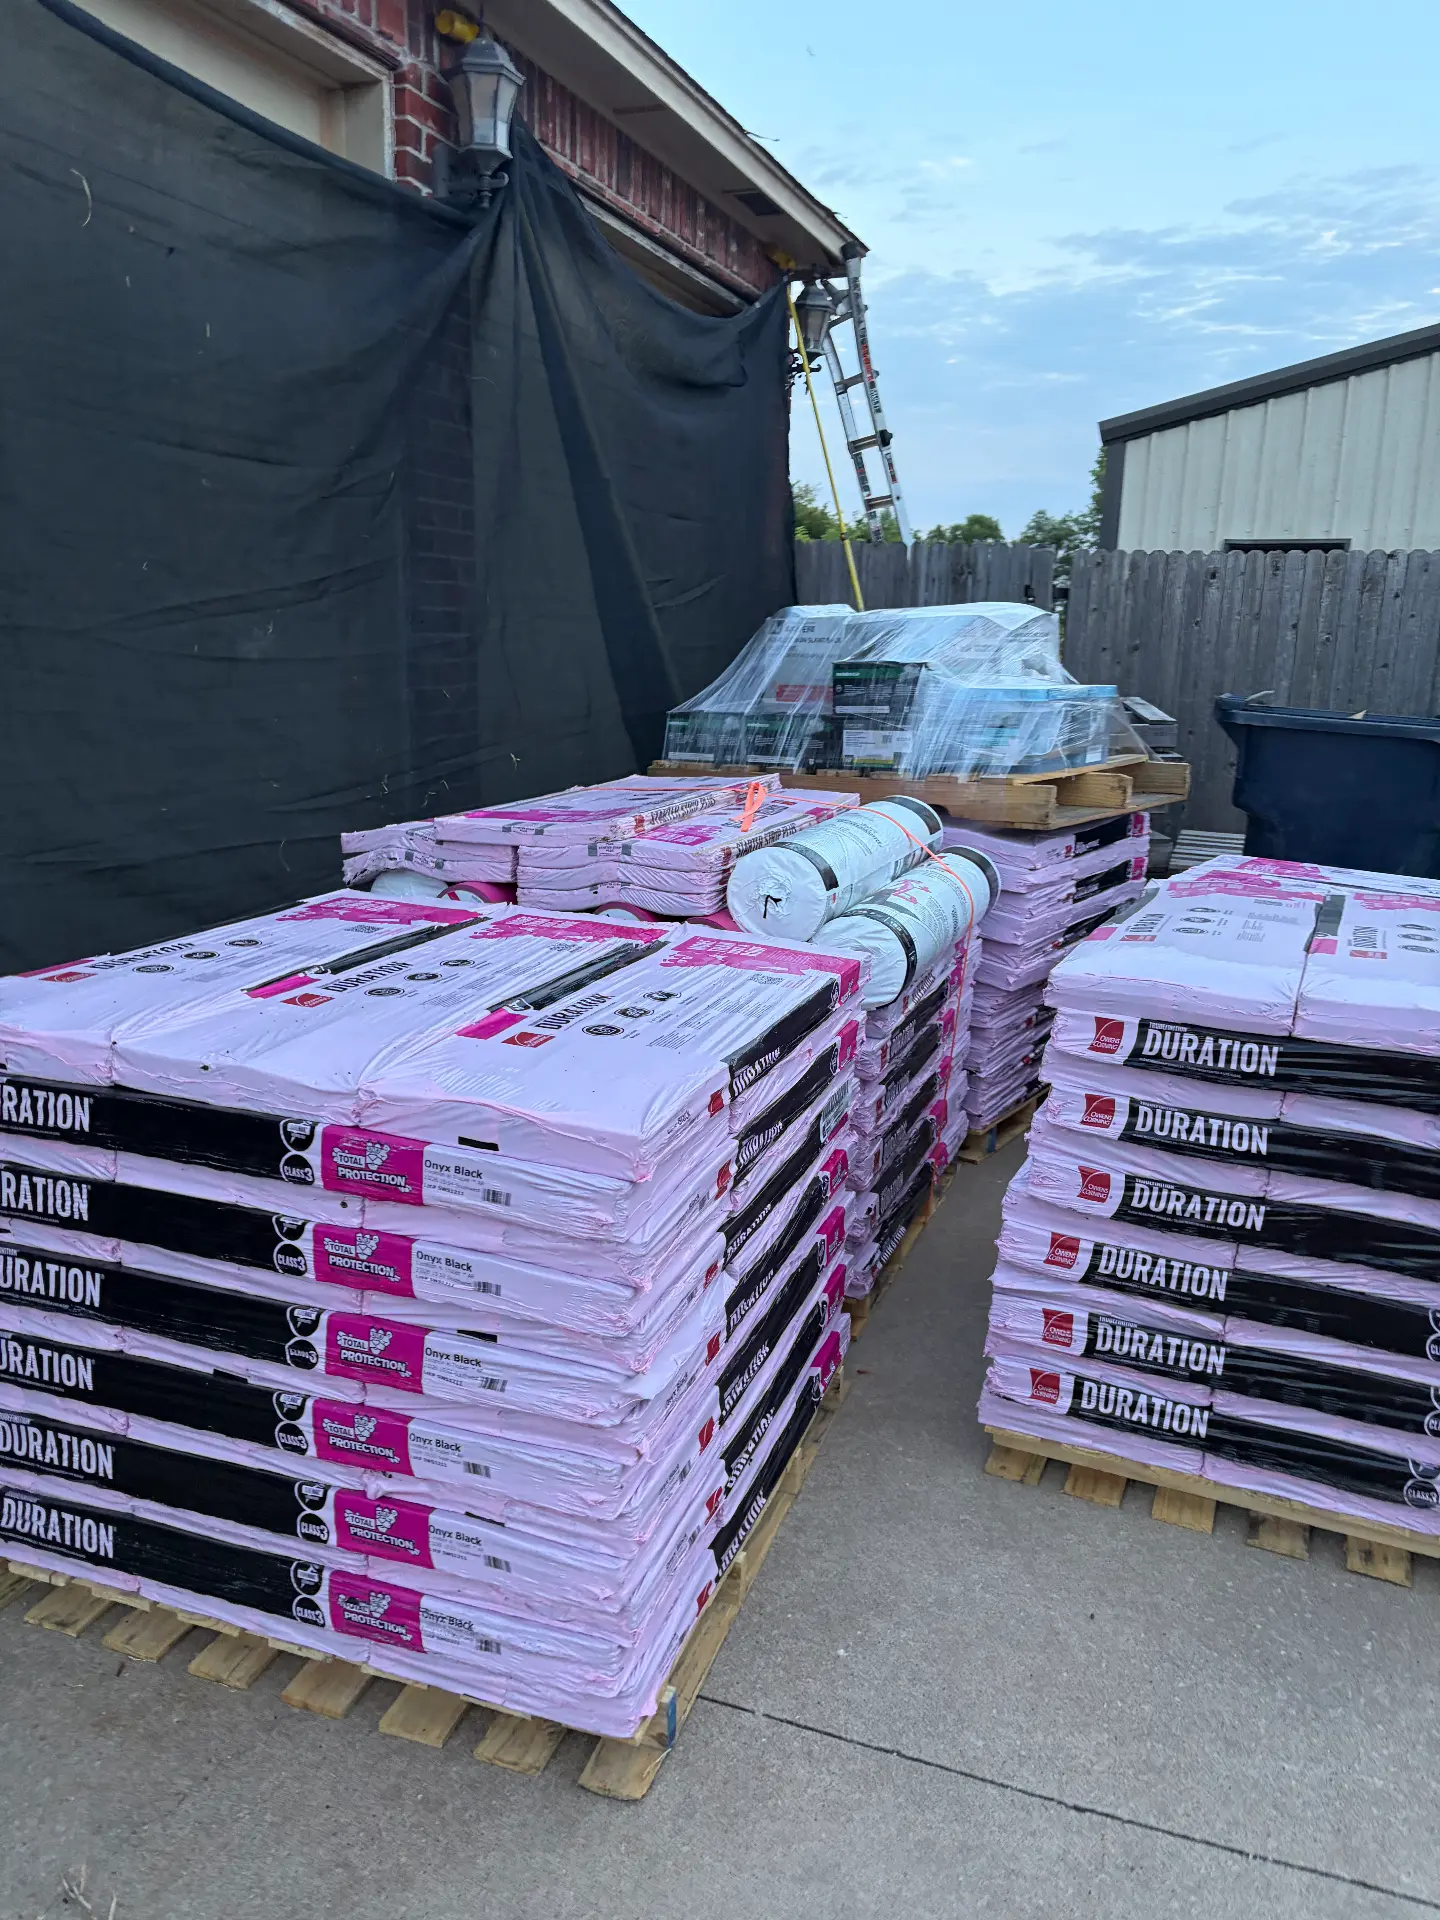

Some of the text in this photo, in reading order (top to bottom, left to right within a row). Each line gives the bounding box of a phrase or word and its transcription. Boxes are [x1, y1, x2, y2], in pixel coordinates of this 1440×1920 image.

[322, 962, 413, 993] DURATION
[534, 993, 615, 1030] DURATION
[1093, 1041, 1118, 1050] CORNING
[1101, 1035, 1121, 1044] OWENS
[1142, 1028, 1279, 1077] DURATION
[0, 1085, 90, 1132] RATION
[1090, 1111, 1112, 1121] OWENS
[1083, 1116, 1111, 1126] CORNING
[1135, 1105, 1268, 1156] DURATION
[339, 1154, 363, 1166] TOTAL
[425, 1160, 451, 1172] Onyx
[454, 1165, 483, 1180] Black
[337, 1167, 406, 1187] PROTECTION
[1082, 1188, 1107, 1199] CORNING
[1088, 1183, 1108, 1194] OWENS
[1131, 1183, 1266, 1232] DURATION
[330, 1243, 354, 1255] TOTAL
[1055, 1249, 1077, 1259] OWENS
[277, 1256, 306, 1271] CLASS 3
[328, 1255, 394, 1277] PROTECTION
[416, 1251, 472, 1272] Onyx Black
[1048, 1254, 1074, 1265] CORNING
[1097, 1246, 1229, 1301] DURATION
[343, 1337, 367, 1350] TOTAL
[1095, 1322, 1226, 1376] DURATION
[340, 1351, 406, 1372] PROTECTION
[425, 1347, 482, 1367] Onyx Black
[1080, 1380, 1209, 1438] DURATION
[278, 1432, 308, 1450] CLASS 3
[329, 1425, 352, 1437] TOTAL
[0, 1420, 113, 1480] DURATION
[329, 1437, 394, 1458] PROTECTION
[409, 1433, 461, 1452] Onyx Black
[1, 1497, 114, 1558] DURATION
[300, 1522, 329, 1541] CLASS 3
[428, 1524, 482, 1546] Onyx Black
[350, 1527, 414, 1550] PROTECTION
[296, 1606, 325, 1625] CLASS 3
[344, 1612, 407, 1635] PROTECTION
